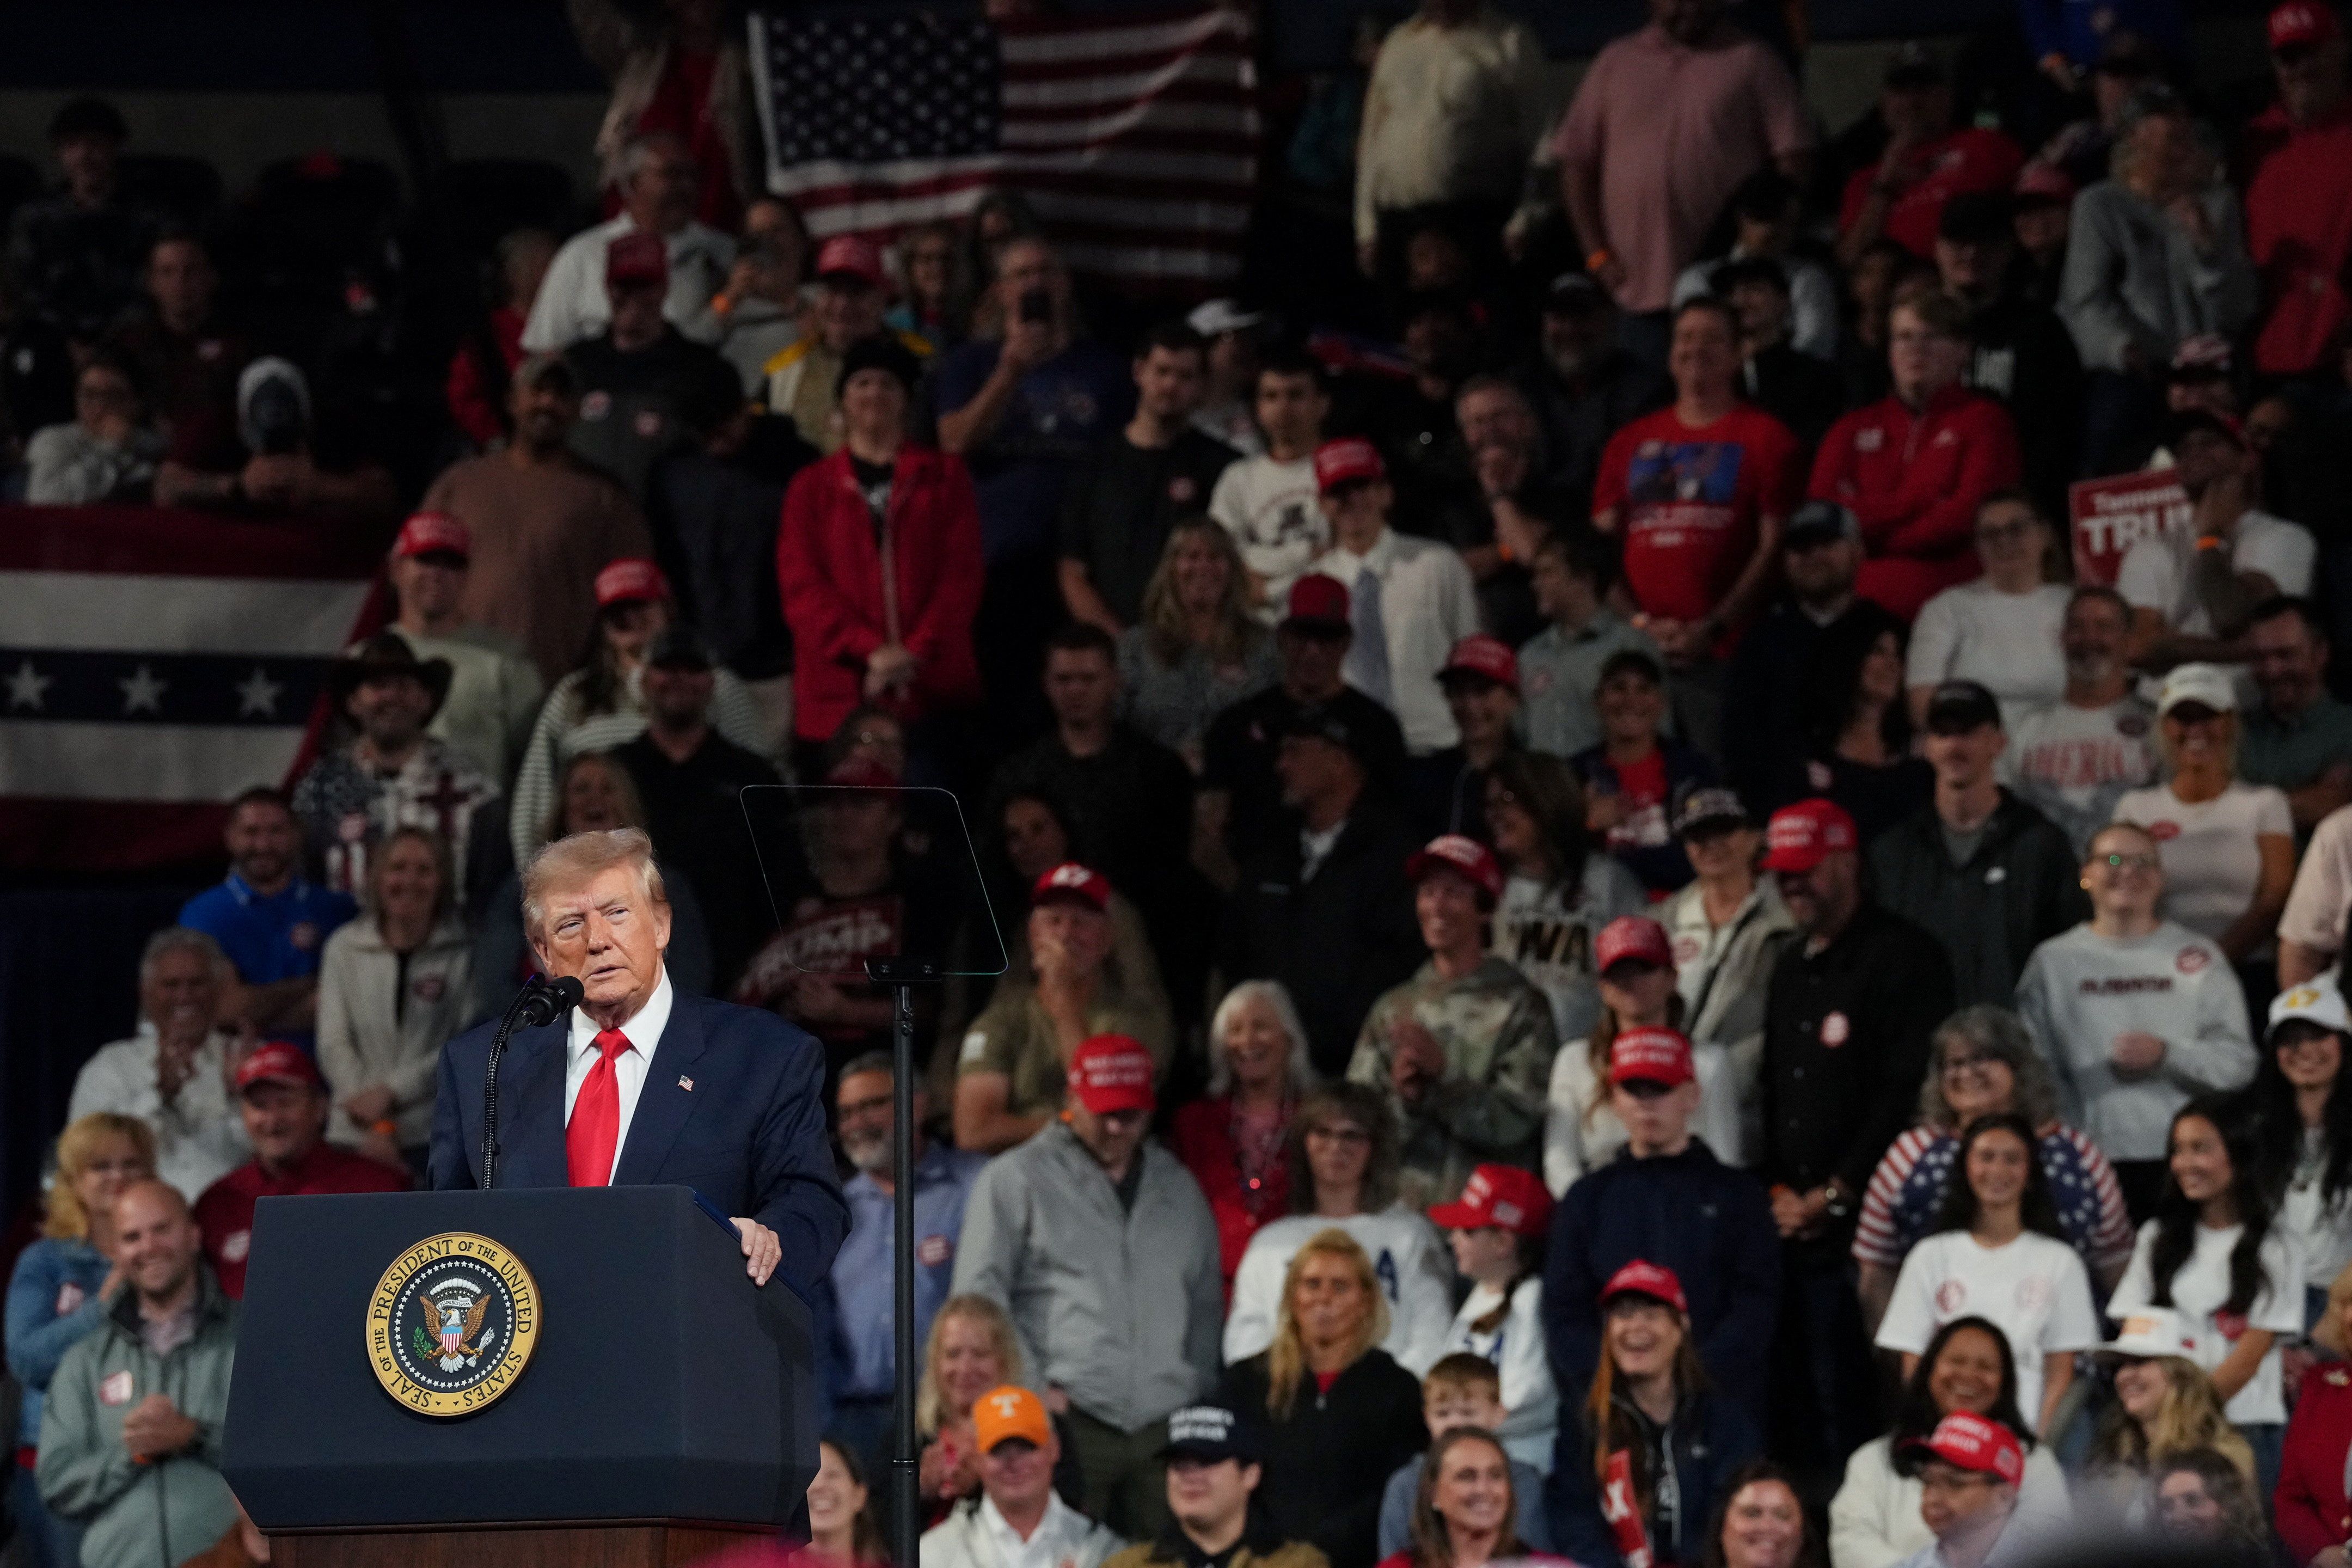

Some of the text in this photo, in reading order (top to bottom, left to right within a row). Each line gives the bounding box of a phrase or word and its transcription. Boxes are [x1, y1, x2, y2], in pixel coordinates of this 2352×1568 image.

[373, 1239, 531, 1407] SEAL OF THE PRESIDENT OF THE UNITED STATES
